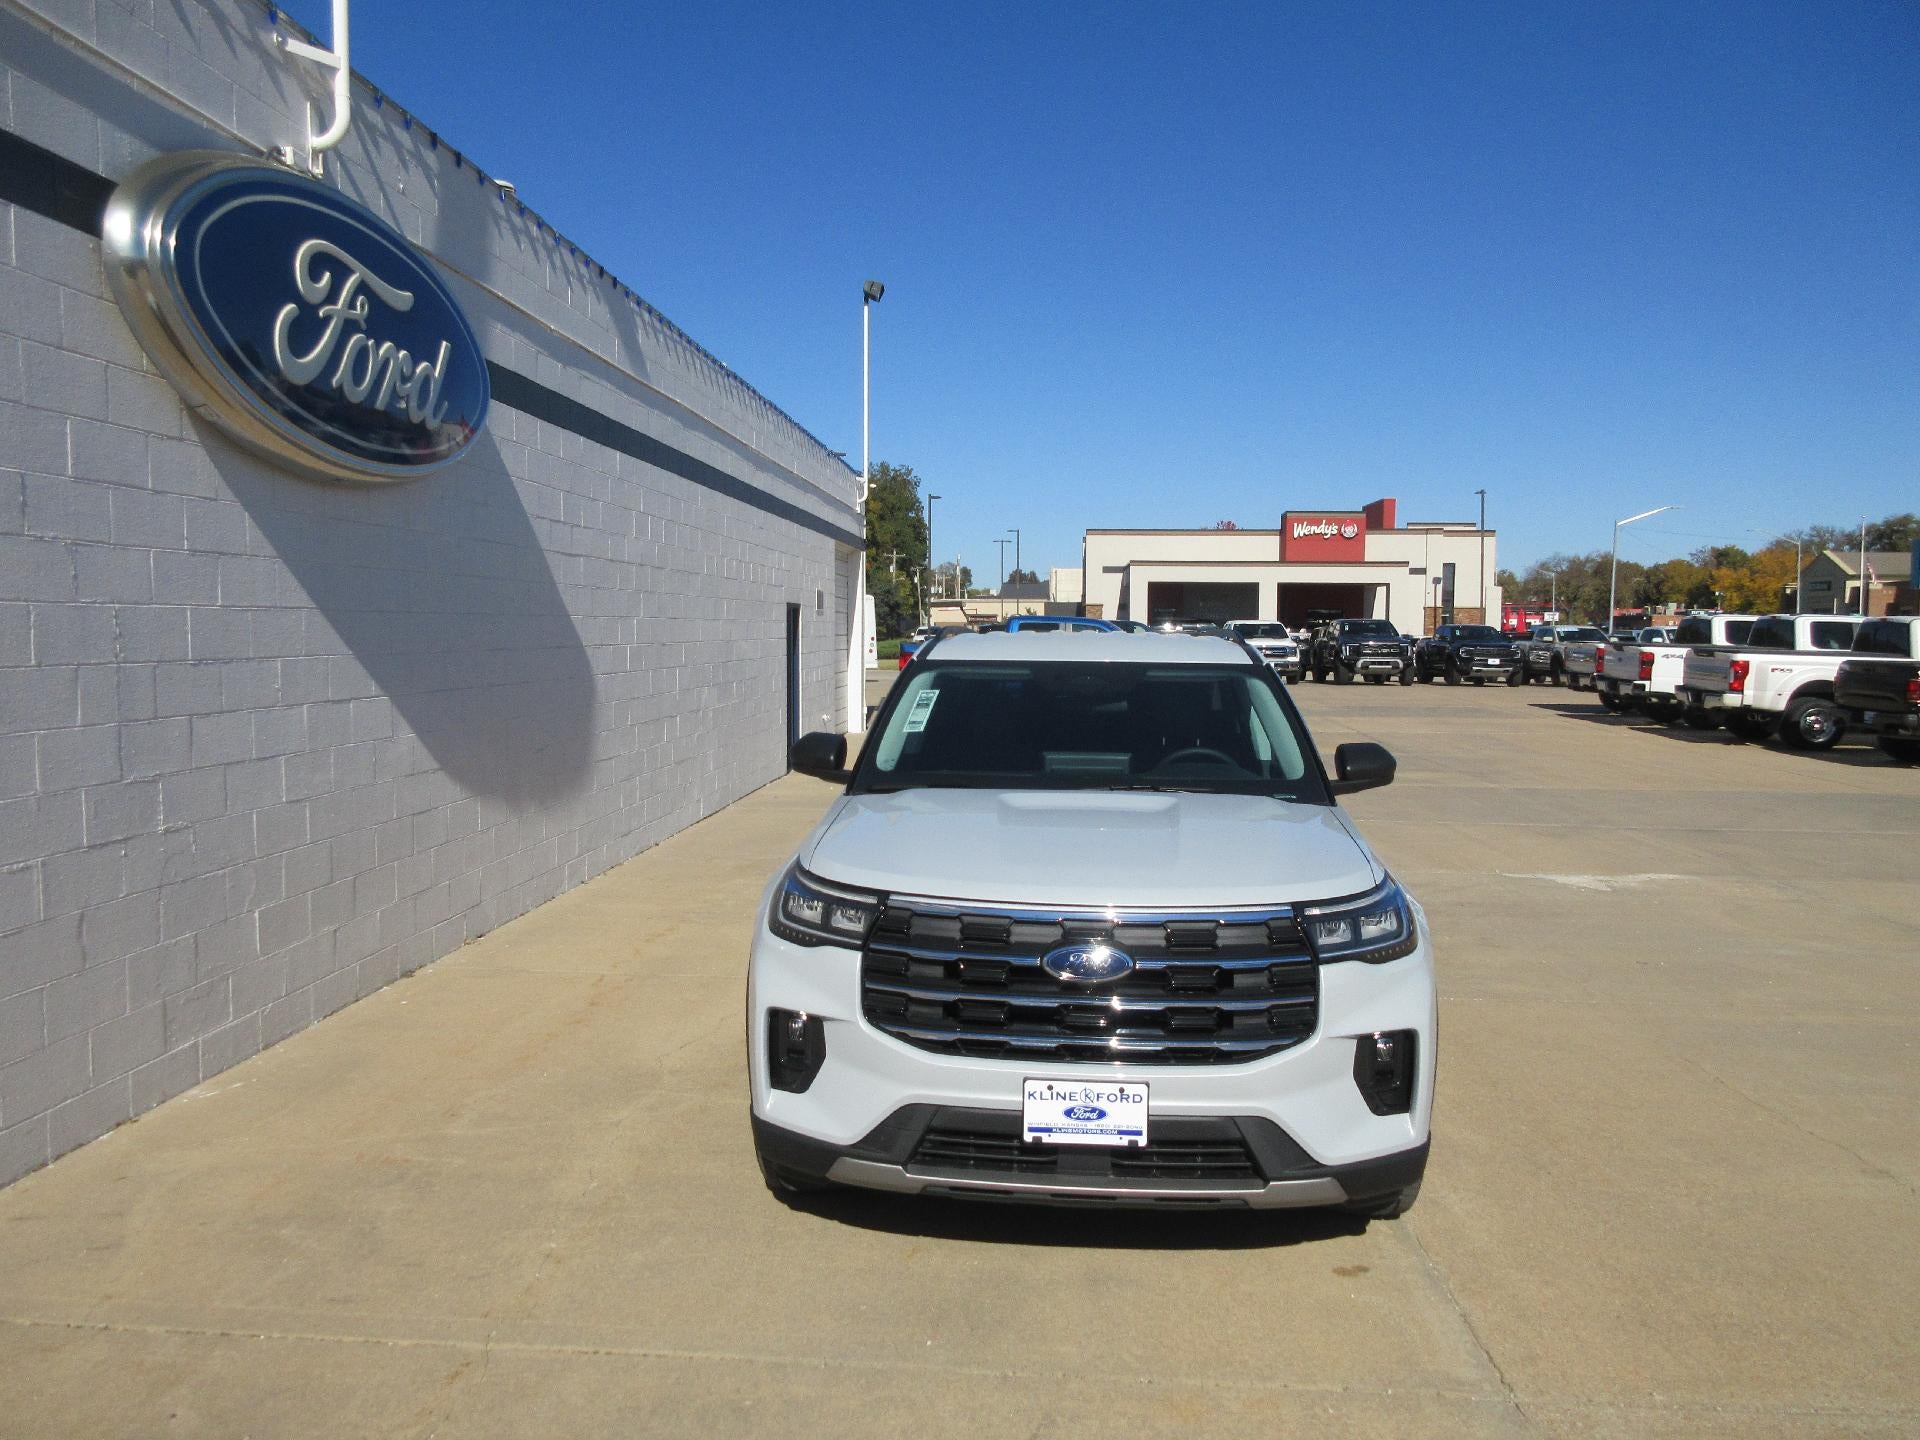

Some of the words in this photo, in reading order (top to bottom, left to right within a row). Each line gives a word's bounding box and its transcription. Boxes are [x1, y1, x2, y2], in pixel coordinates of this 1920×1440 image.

[273, 239, 451, 431] Ford
[1293, 519, 1338, 539] Wendy's
[1028, 1090, 1078, 1101] KLINE
[1096, 1092, 1143, 1104] FORD
[1070, 1106, 1099, 1120] Ford
